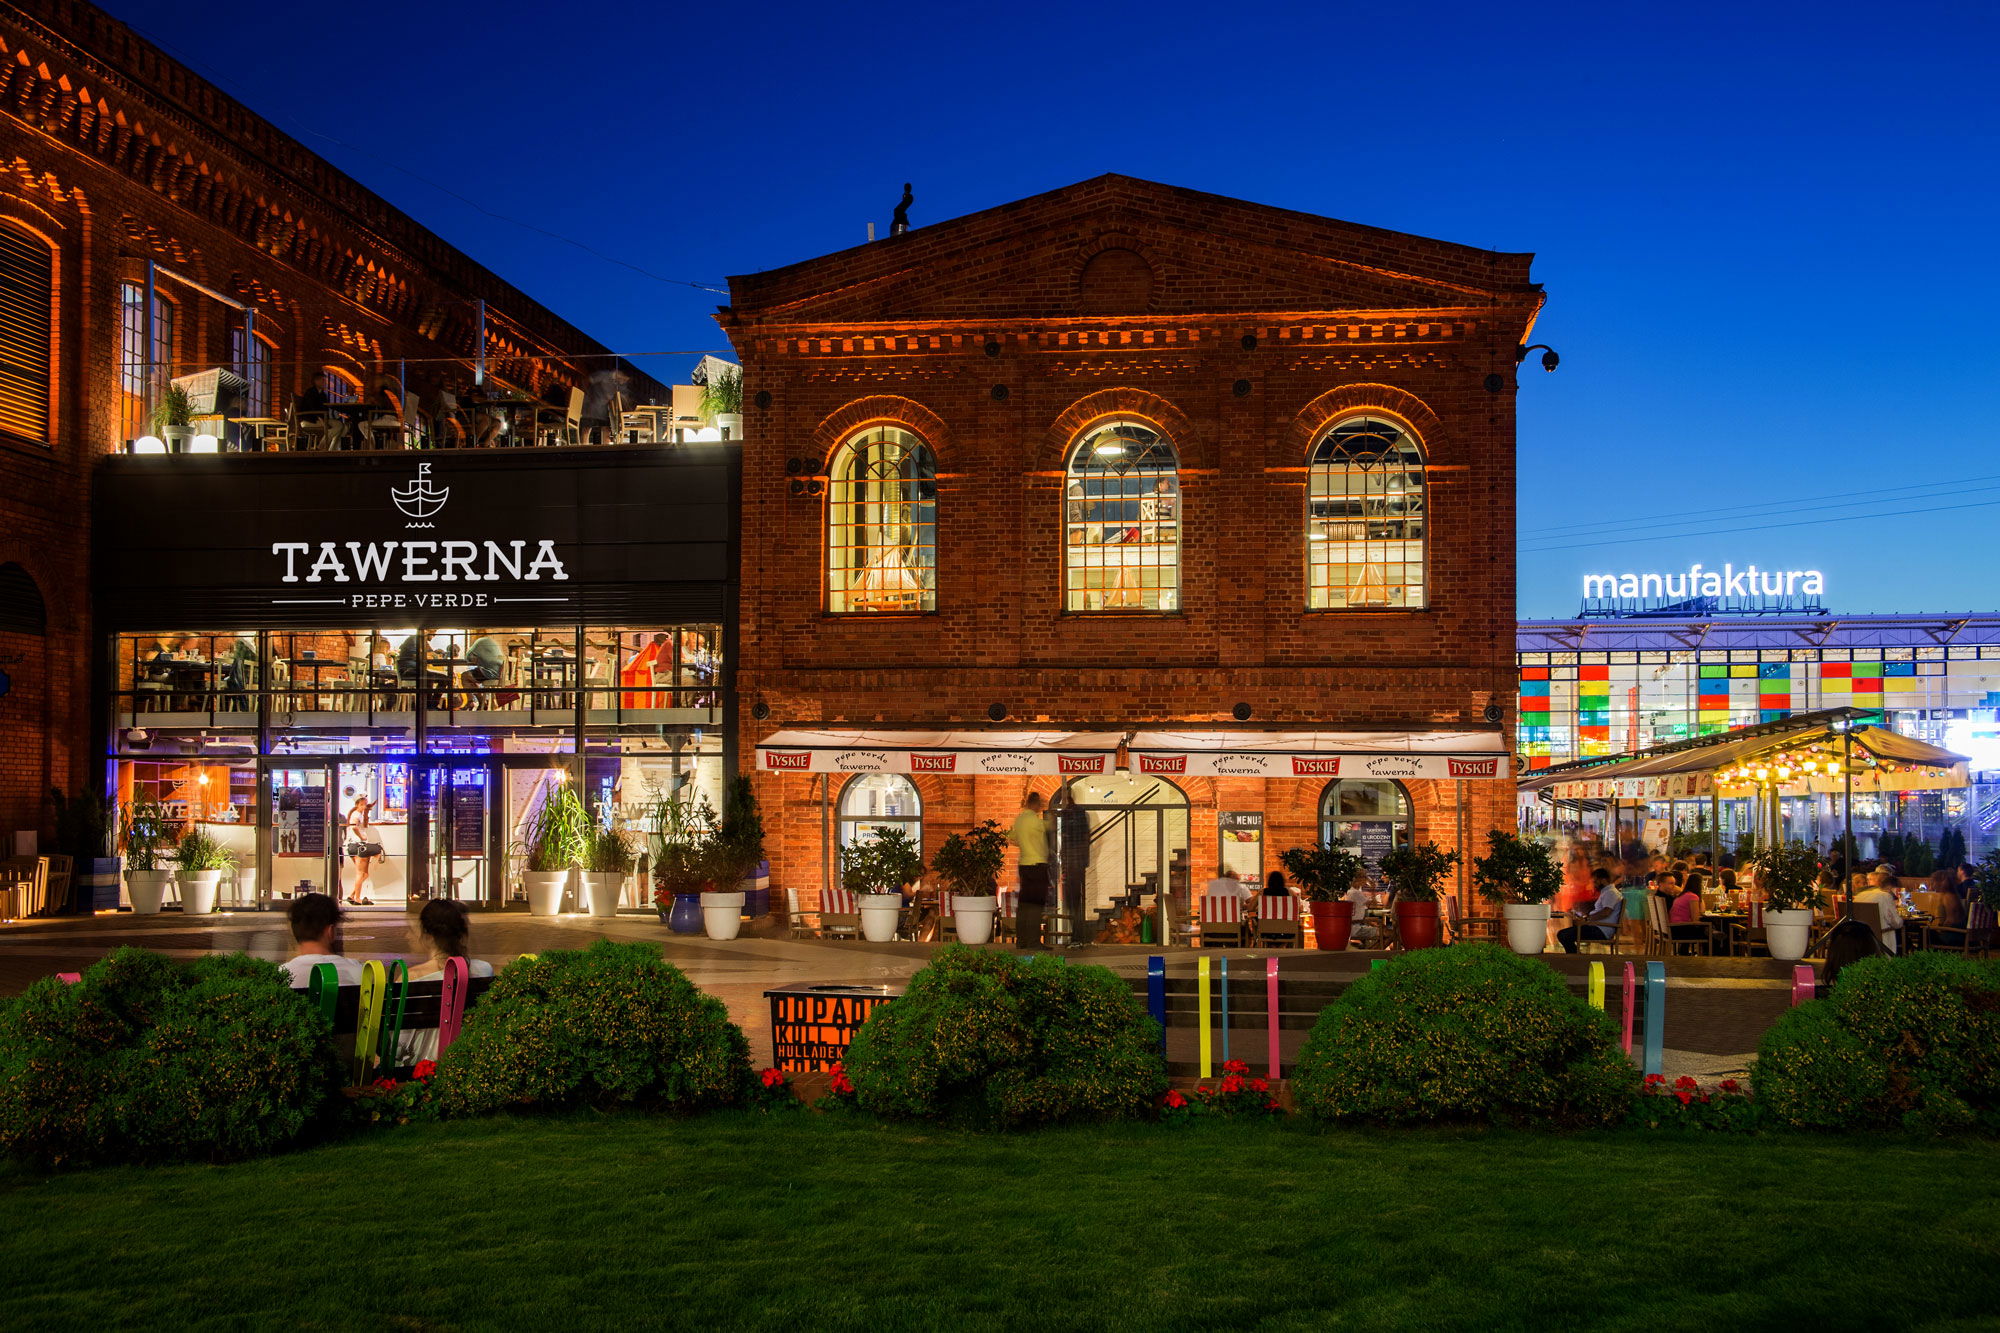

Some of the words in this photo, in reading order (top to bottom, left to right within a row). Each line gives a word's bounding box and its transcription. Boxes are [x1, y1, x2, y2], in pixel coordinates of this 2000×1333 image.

[272, 540, 569, 582] TAWERNA
[1583, 563, 1824, 598] manufaktura
[768, 754, 808, 767] TYSKIE
[834, 752, 856, 764] pepe
[861, 752, 888, 764] verde
[914, 756, 952, 770] TYSKIE
[980, 754, 1002, 766] pepe
[1008, 754, 1036, 766] verde
[1060, 758, 1102, 771] TYSKIE
[1142, 758, 1184, 772] TYSKIE
[1212, 755, 1234, 768] pepe
[1240, 755, 1268, 768] verde
[1366, 756, 1389, 770] pepe
[1394, 756, 1424, 770] verde
[1294, 760, 1336, 774] TYSKIE
[1450, 761, 1494, 775] TYSKIE
[1236, 816, 1258, 825] MENU
